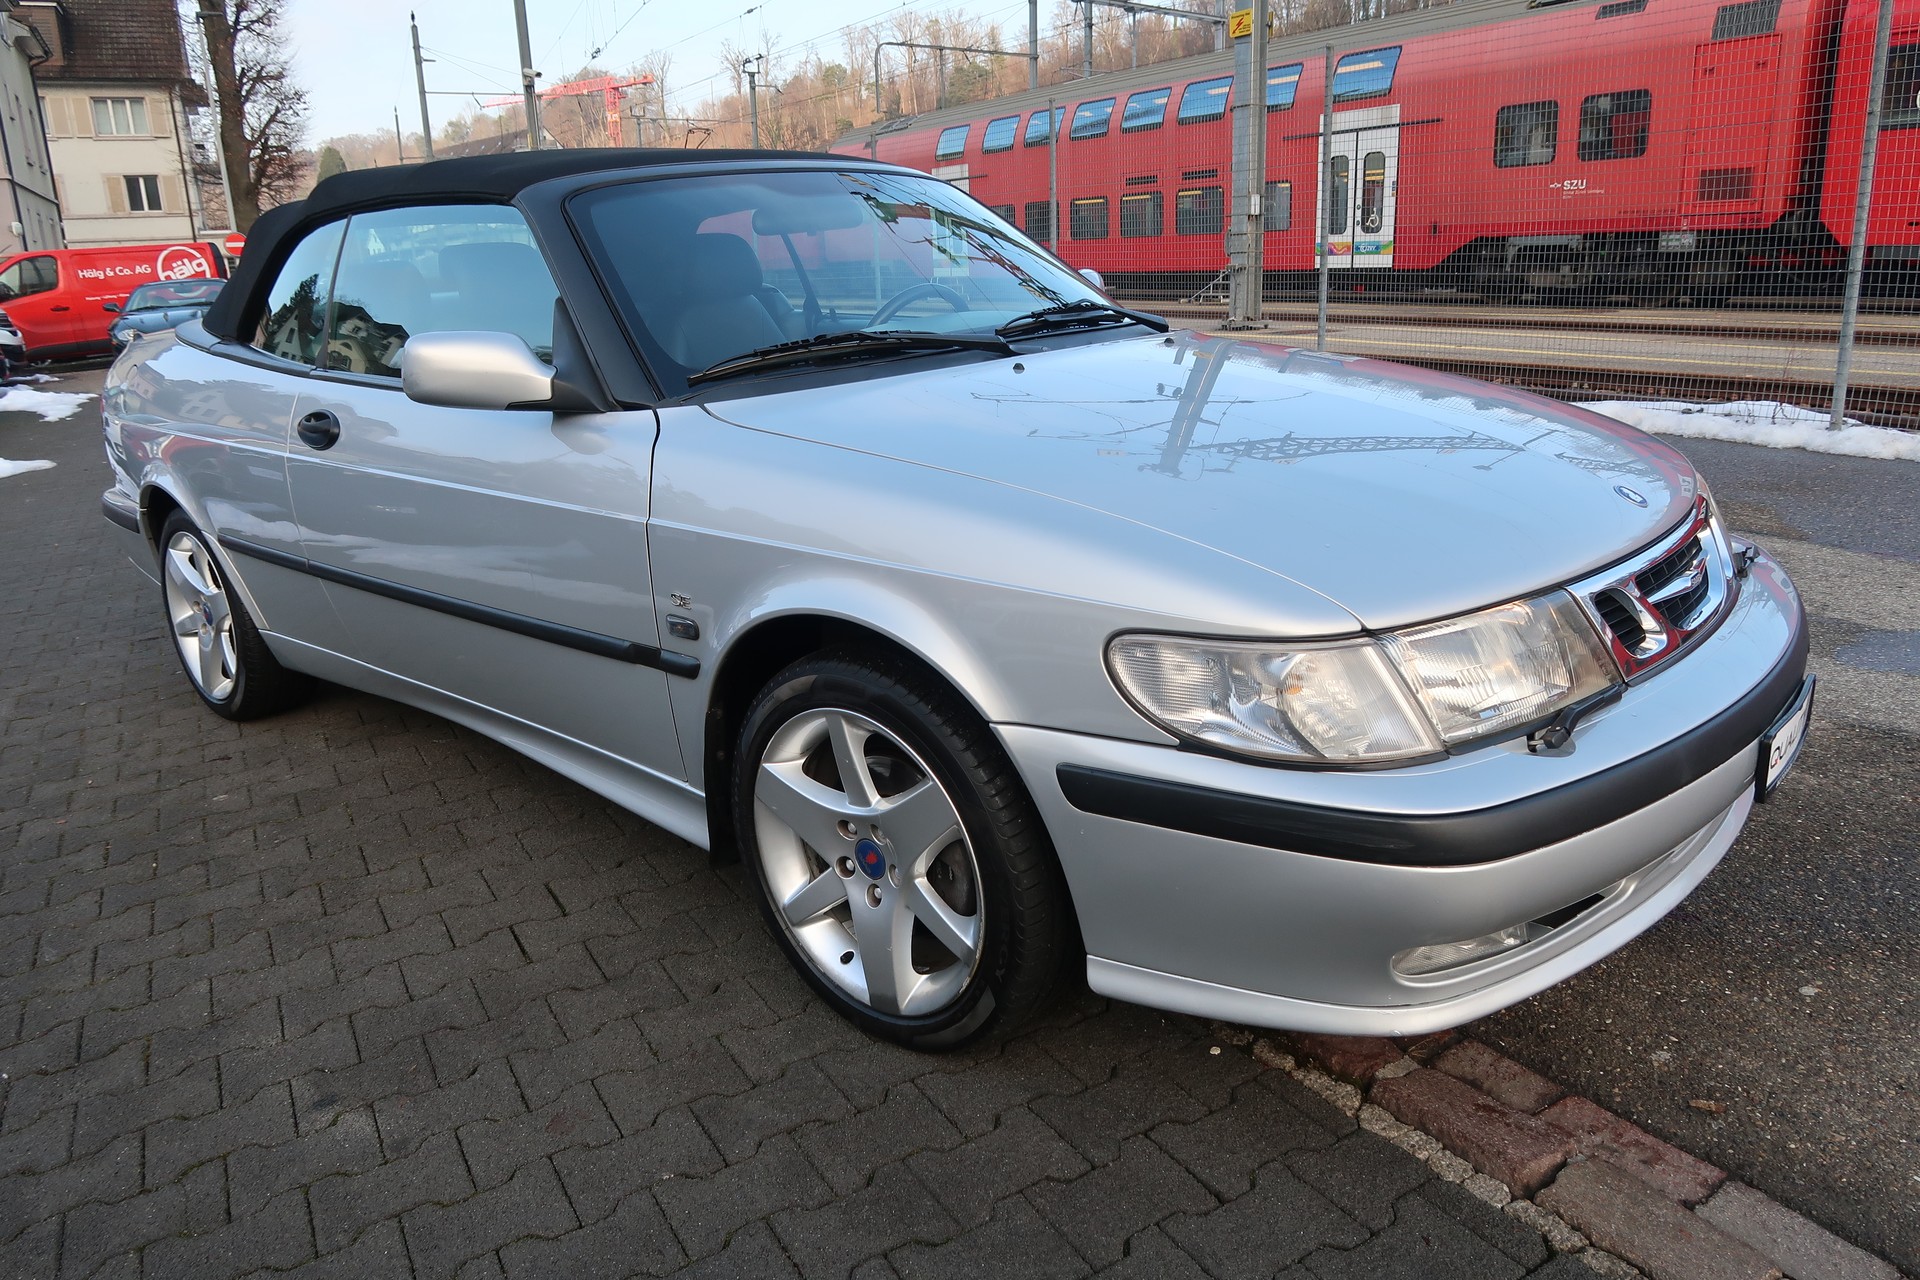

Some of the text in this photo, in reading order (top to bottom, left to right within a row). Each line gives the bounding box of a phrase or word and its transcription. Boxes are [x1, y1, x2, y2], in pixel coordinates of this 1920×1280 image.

[1563, 179, 1587, 190] SZU
[78, 264, 152, 279] Hälg & Co. AG
